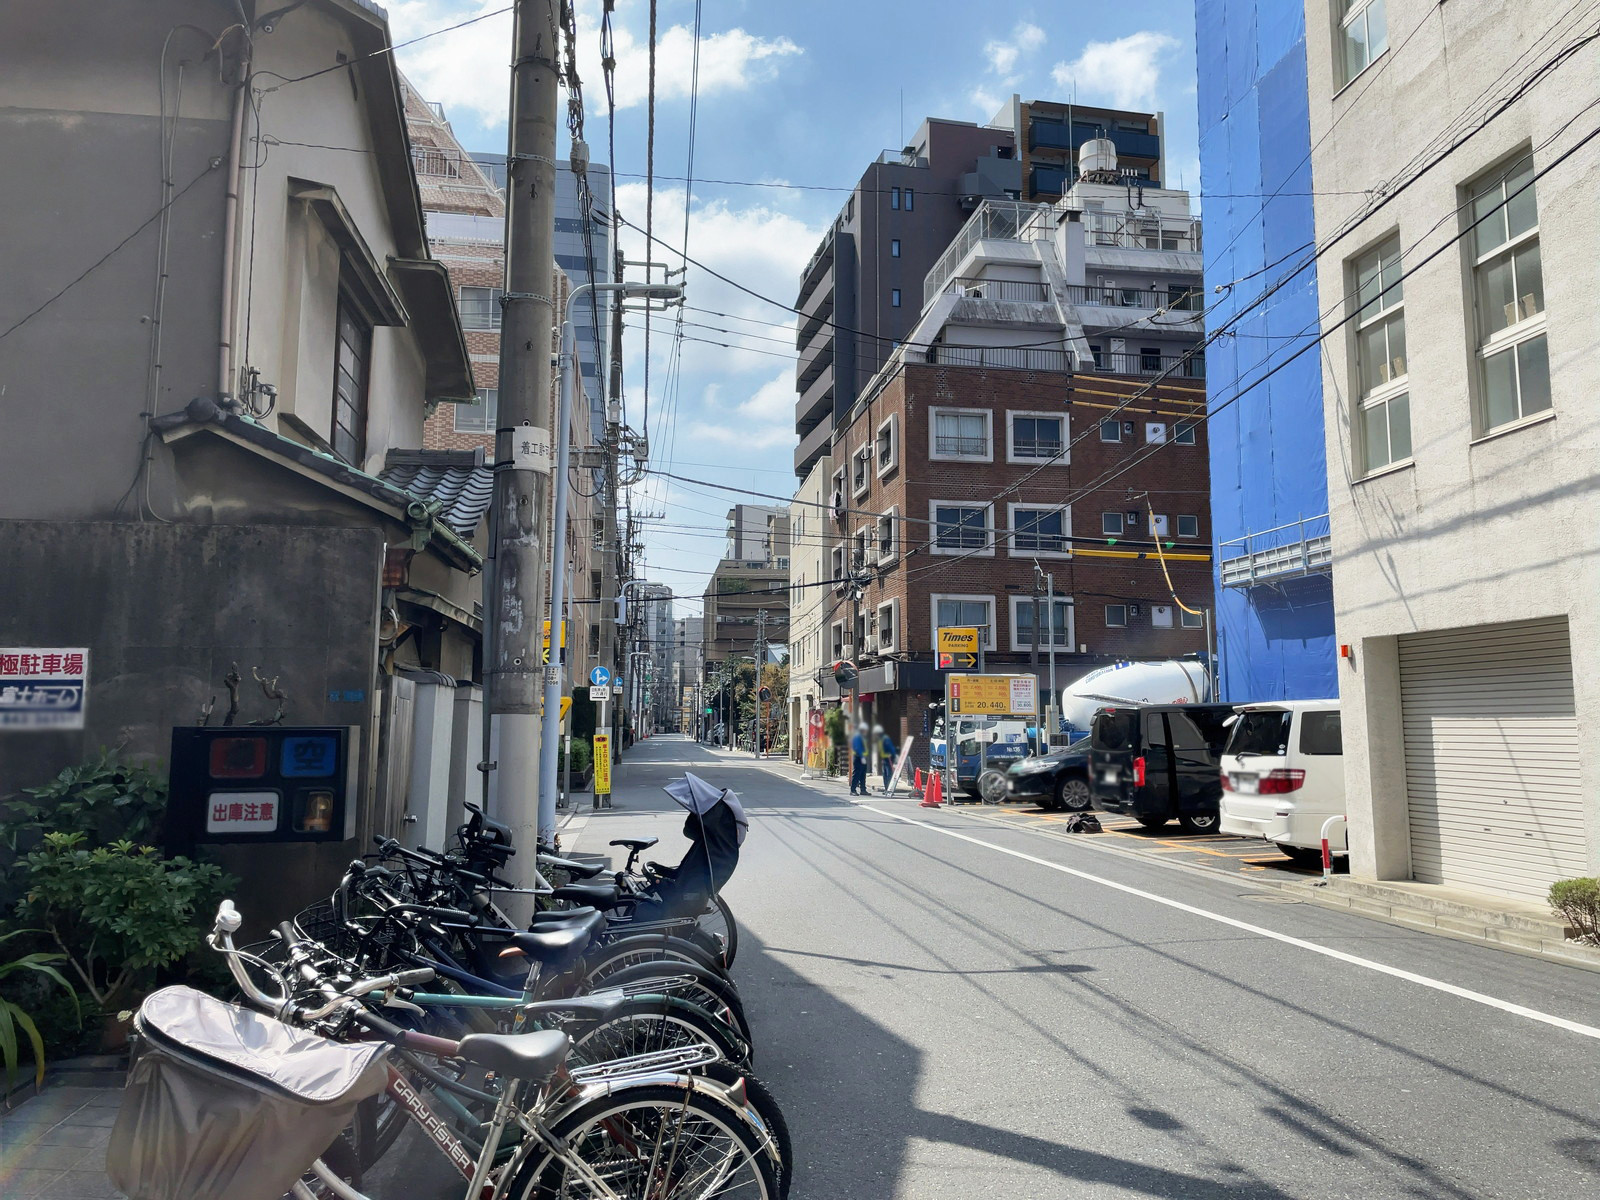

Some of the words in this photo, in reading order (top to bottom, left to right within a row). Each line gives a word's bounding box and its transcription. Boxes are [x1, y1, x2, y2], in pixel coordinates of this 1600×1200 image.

[943, 632, 974, 642] Times
[940, 653, 953, 668] P
[293, 740, 327, 771] 空
[212, 803, 275, 823] 出庫注意
[393, 1078, 428, 1120] GARY
[425, 1116, 471, 1170] FISHER
